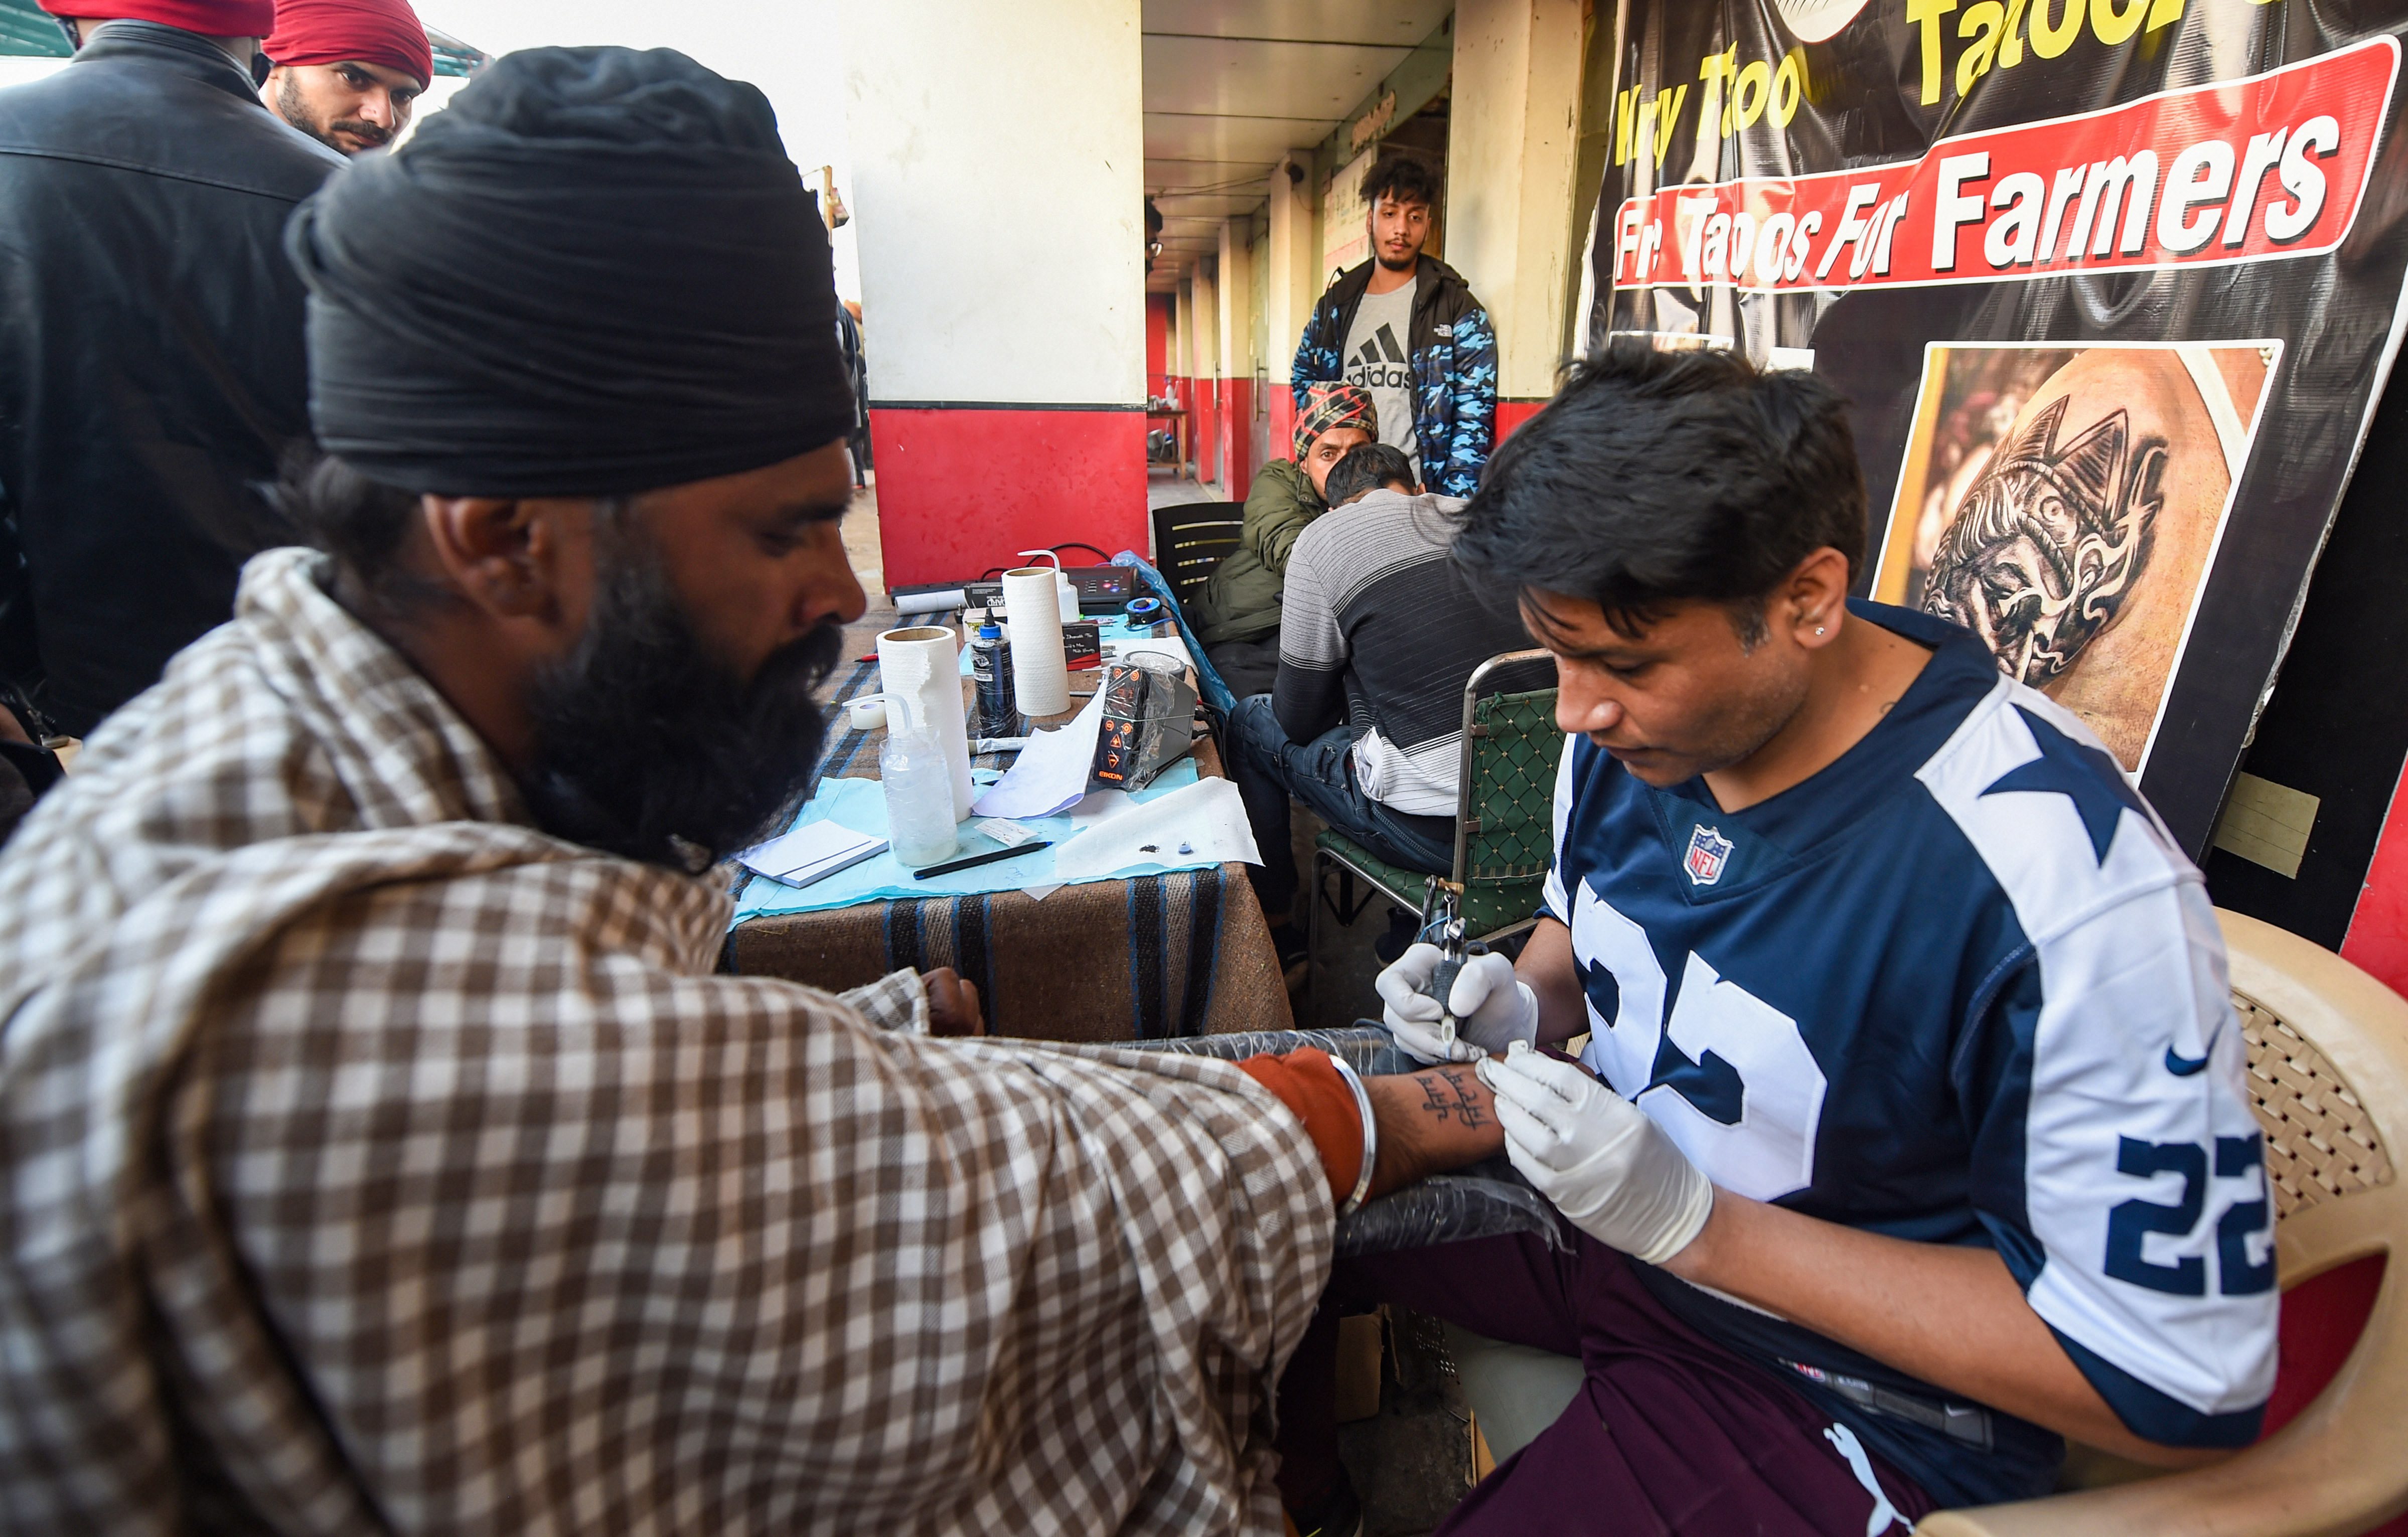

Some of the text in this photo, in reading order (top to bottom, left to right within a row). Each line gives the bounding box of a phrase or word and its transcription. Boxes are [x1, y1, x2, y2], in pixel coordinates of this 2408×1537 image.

[1815, 183, 1909, 280] For
[1931, 115, 2340, 271] Farmers
[1346, 364, 1410, 389] didas
[1099, 771, 1123, 781] EIKON
[1690, 848, 1716, 876] NFL
[2104, 1131, 2279, 1297] 22
